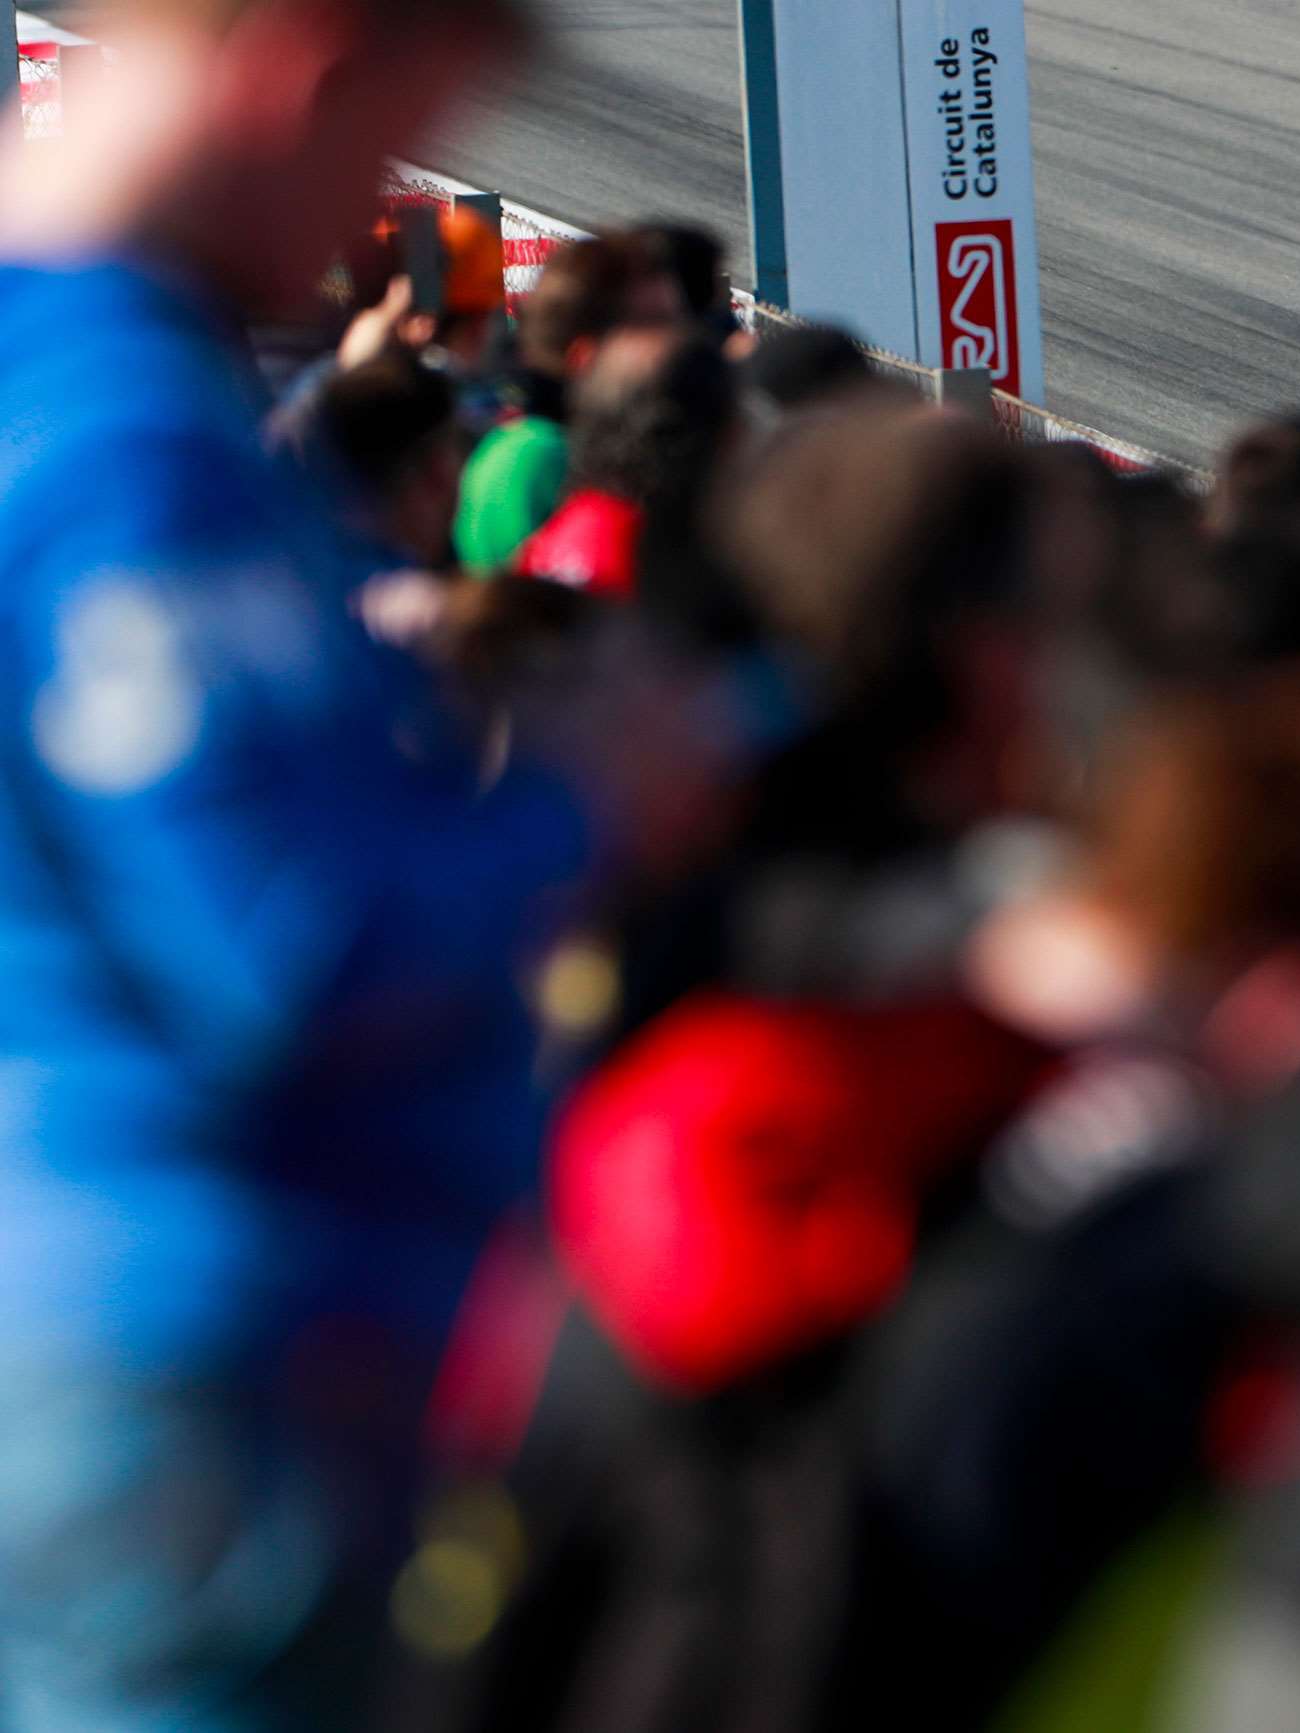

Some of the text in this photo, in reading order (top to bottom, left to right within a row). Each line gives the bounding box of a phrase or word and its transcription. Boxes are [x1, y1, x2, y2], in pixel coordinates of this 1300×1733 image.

[934, 37, 968, 200] Circuit de
[968, 26, 998, 198] Catalunya
